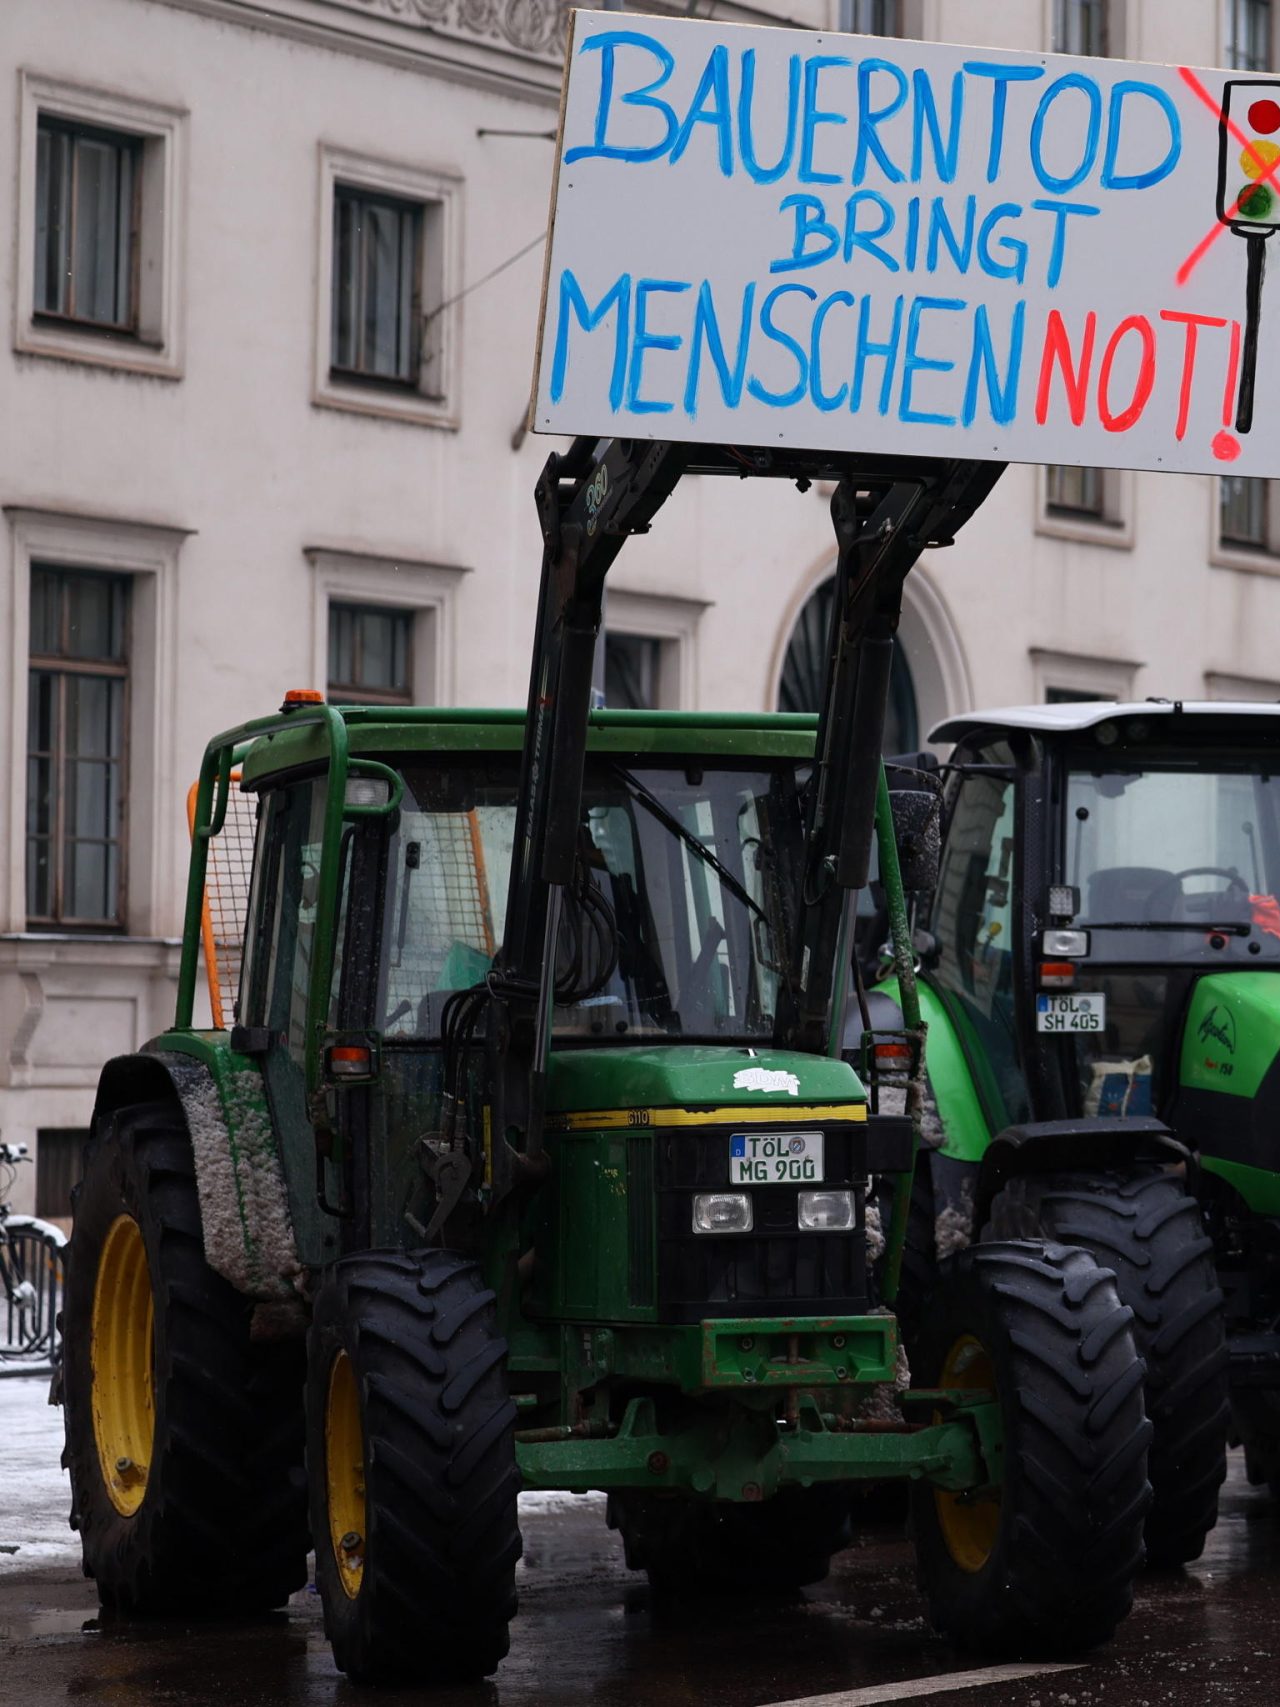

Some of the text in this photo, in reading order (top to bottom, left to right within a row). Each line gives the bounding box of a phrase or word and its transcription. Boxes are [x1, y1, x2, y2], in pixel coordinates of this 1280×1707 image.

[564, 30, 1182, 193] BAUERNTOD
[770, 193, 1100, 288] BRINGT
[551, 269, 1025, 427] MENSCHEN
[1050, 996, 1079, 1012] TÖL
[1044, 1014, 1099, 1030] SH 405
[748, 1138, 790, 1158] TÖL
[739, 1160, 815, 1181] MG 900
